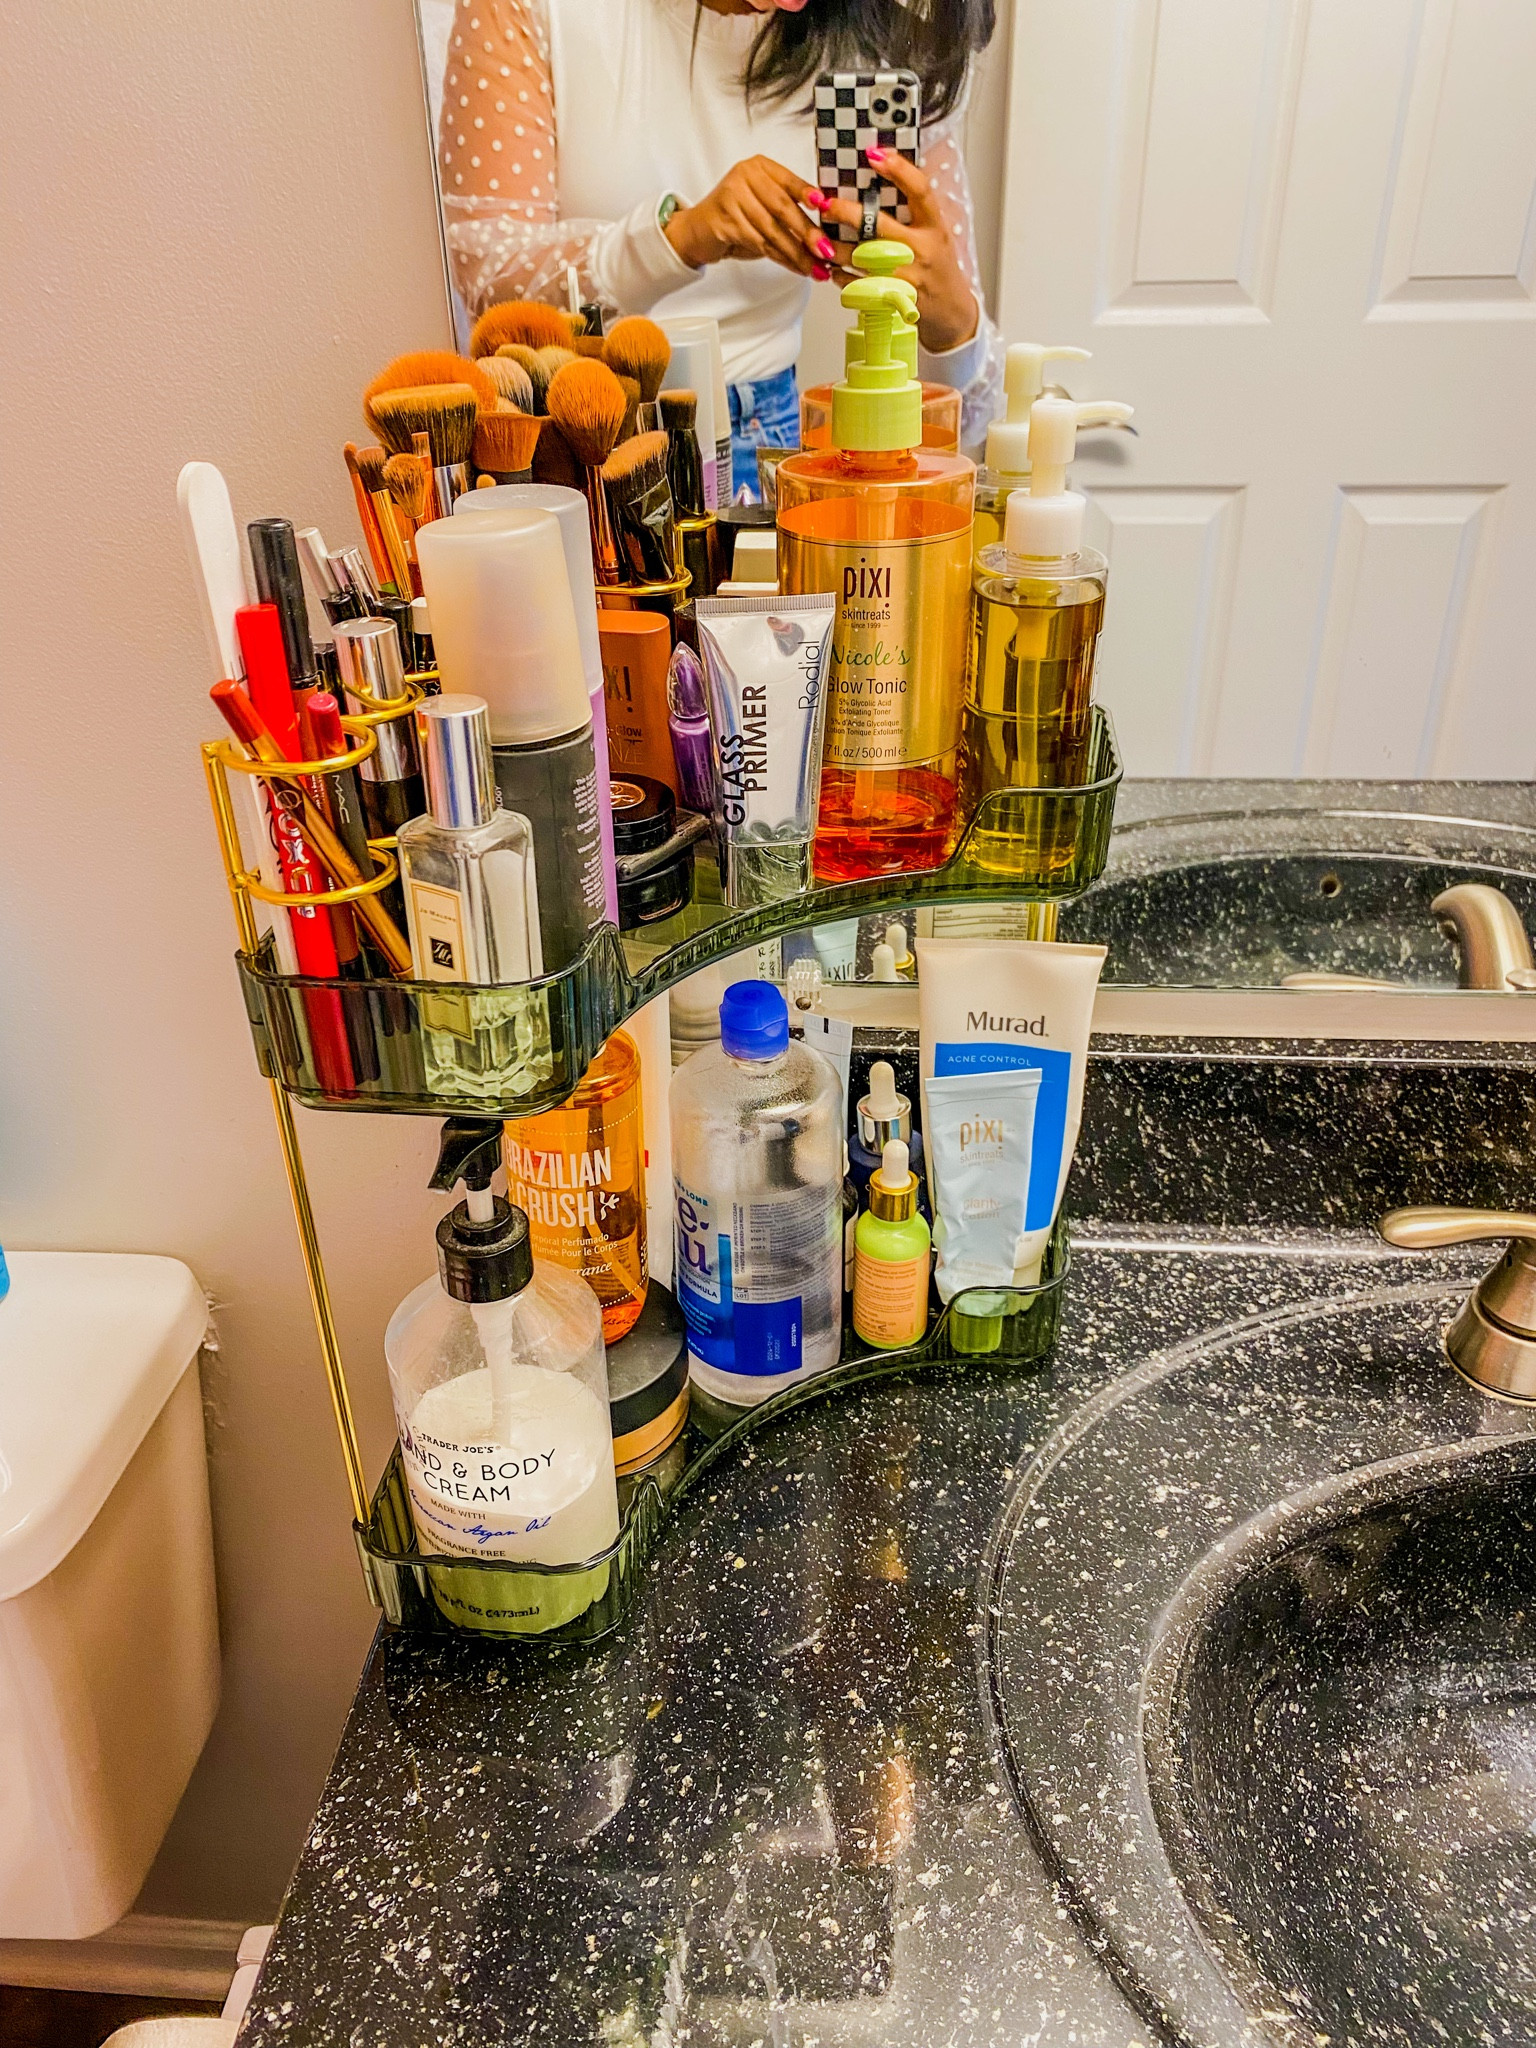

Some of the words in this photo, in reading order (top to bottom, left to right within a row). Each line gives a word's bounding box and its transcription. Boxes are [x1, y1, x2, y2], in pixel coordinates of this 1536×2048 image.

[842, 557, 891, 608] pixi
[841, 608, 891, 621] skintreats
[832, 641, 911, 666] Nicole's
[798, 641, 820, 710] Rodial
[827, 676, 862, 694] Glow
[865, 677, 908, 695] Tonic
[838, 706, 872, 716] Exfoliating
[874, 708, 892, 716] Toner
[850, 699, 876, 707] Glycolic
[877, 699, 892, 707] Acid
[841, 718, 865, 727] d'Acide
[866, 718, 900, 728] Glycolique
[847, 728, 872, 737] Tonique
[873, 726, 904, 736] Exfoliante
[742, 685, 768, 792] PRIMER
[861, 747, 883, 758] 500
[720, 734, 746, 827] GLASS
[947, 1055, 977, 1064] ACNE
[979, 1055, 1032, 1067] CONTROL
[960, 1113, 1005, 1152] pixi
[960, 1151, 1005, 1164] skintreats
[530, 1233, 560, 1247] orporal
[561, 1232, 610, 1247] Perfumado
[561, 1246, 582, 1257] Pour
[583, 1245, 593, 1256] le
[594, 1240, 618, 1255] Corps
[573, 1260, 613, 1278] rance
[421, 1432, 459, 1451] TRADER
[462, 1445, 495, 1454] JOE'S
[452, 1462, 468, 1479] &
[481, 1448, 556, 1481] BODY
[423, 1471, 511, 1503] CREAM
[430, 1499, 456, 1516] MADE
[458, 1510, 486, 1521] WITH
[462, 1524, 518, 1545] Argan
[525, 1515, 553, 1533] Oil
[426, 1527, 478, 1556] FRAGRANCE
[480, 1549, 507, 1558] FREE
[468, 1604, 483, 1616] OZ
